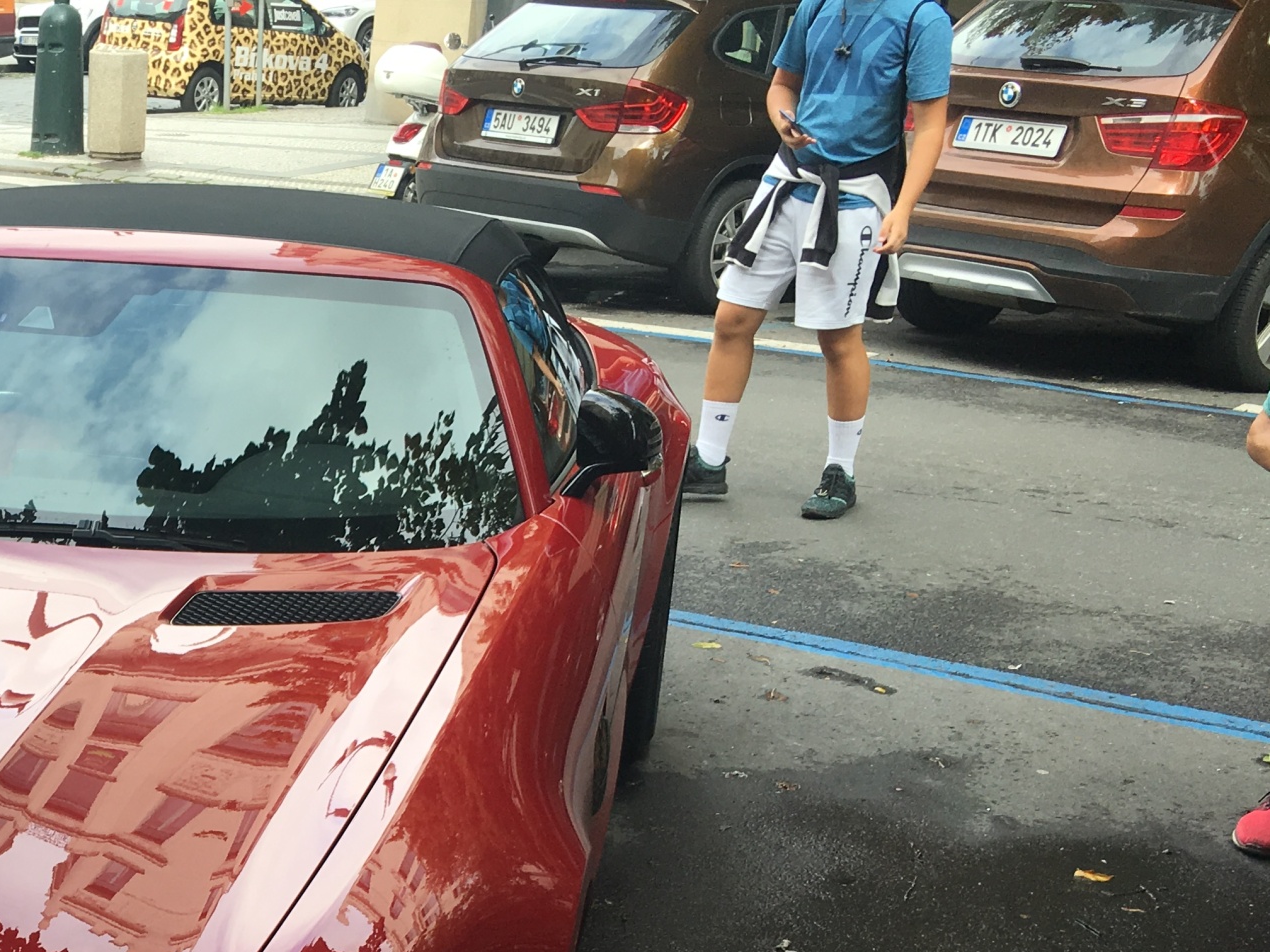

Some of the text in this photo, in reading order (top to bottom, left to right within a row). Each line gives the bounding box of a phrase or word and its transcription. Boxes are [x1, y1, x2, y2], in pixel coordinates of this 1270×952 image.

[314, 53, 329, 74] 4
[575, 87, 601, 97] X1
[1101, 96, 1148, 108] X3
[493, 112, 552, 135] 5AU 3494
[973, 123, 1055, 149] 1TK 2024
[844, 225, 873, 318] Champion
